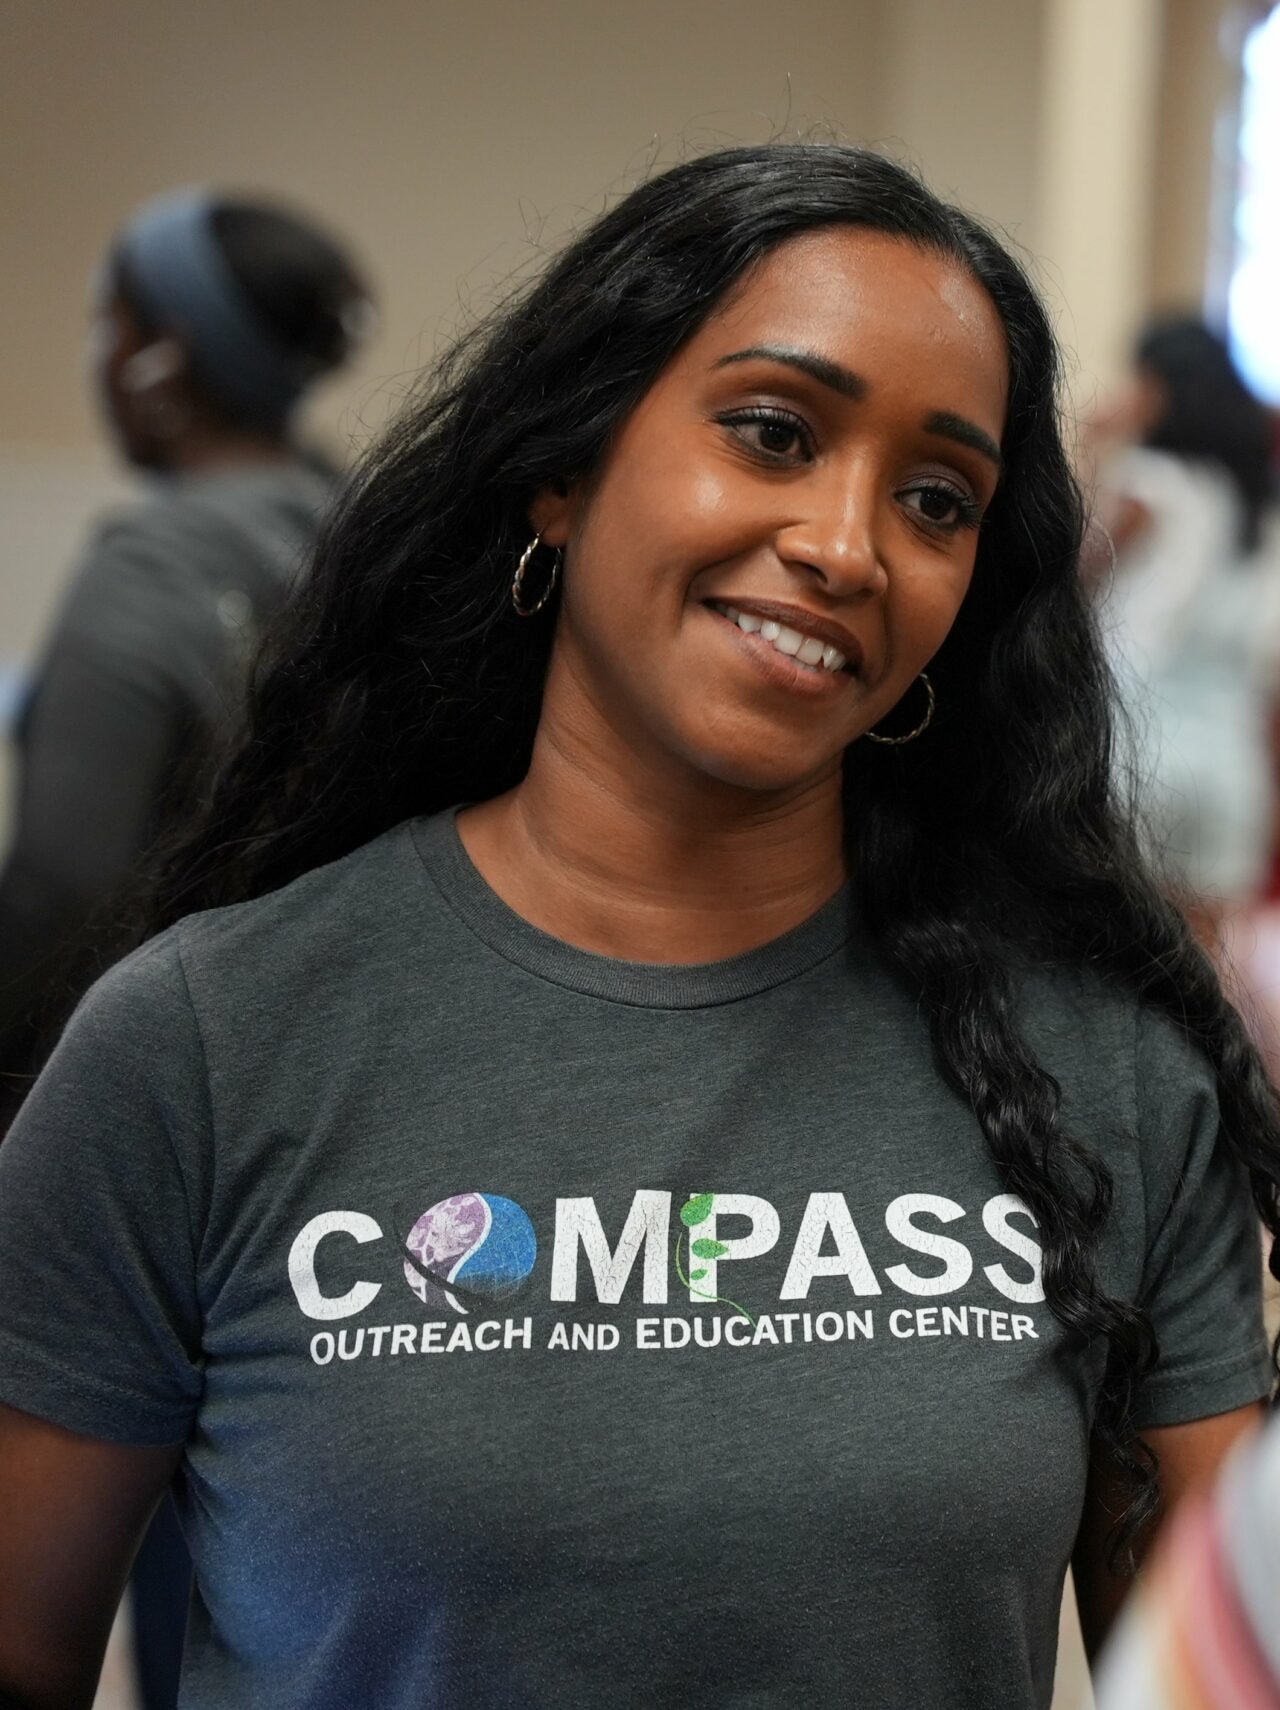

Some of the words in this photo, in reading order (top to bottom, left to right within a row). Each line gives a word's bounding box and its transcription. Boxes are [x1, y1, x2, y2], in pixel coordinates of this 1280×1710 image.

[309, 1317, 533, 1365] OUTREACH
[547, 1322, 620, 1351] AND
[636, 1309, 874, 1349] EDUCATION
[888, 1305, 1040, 1342] CENTER
